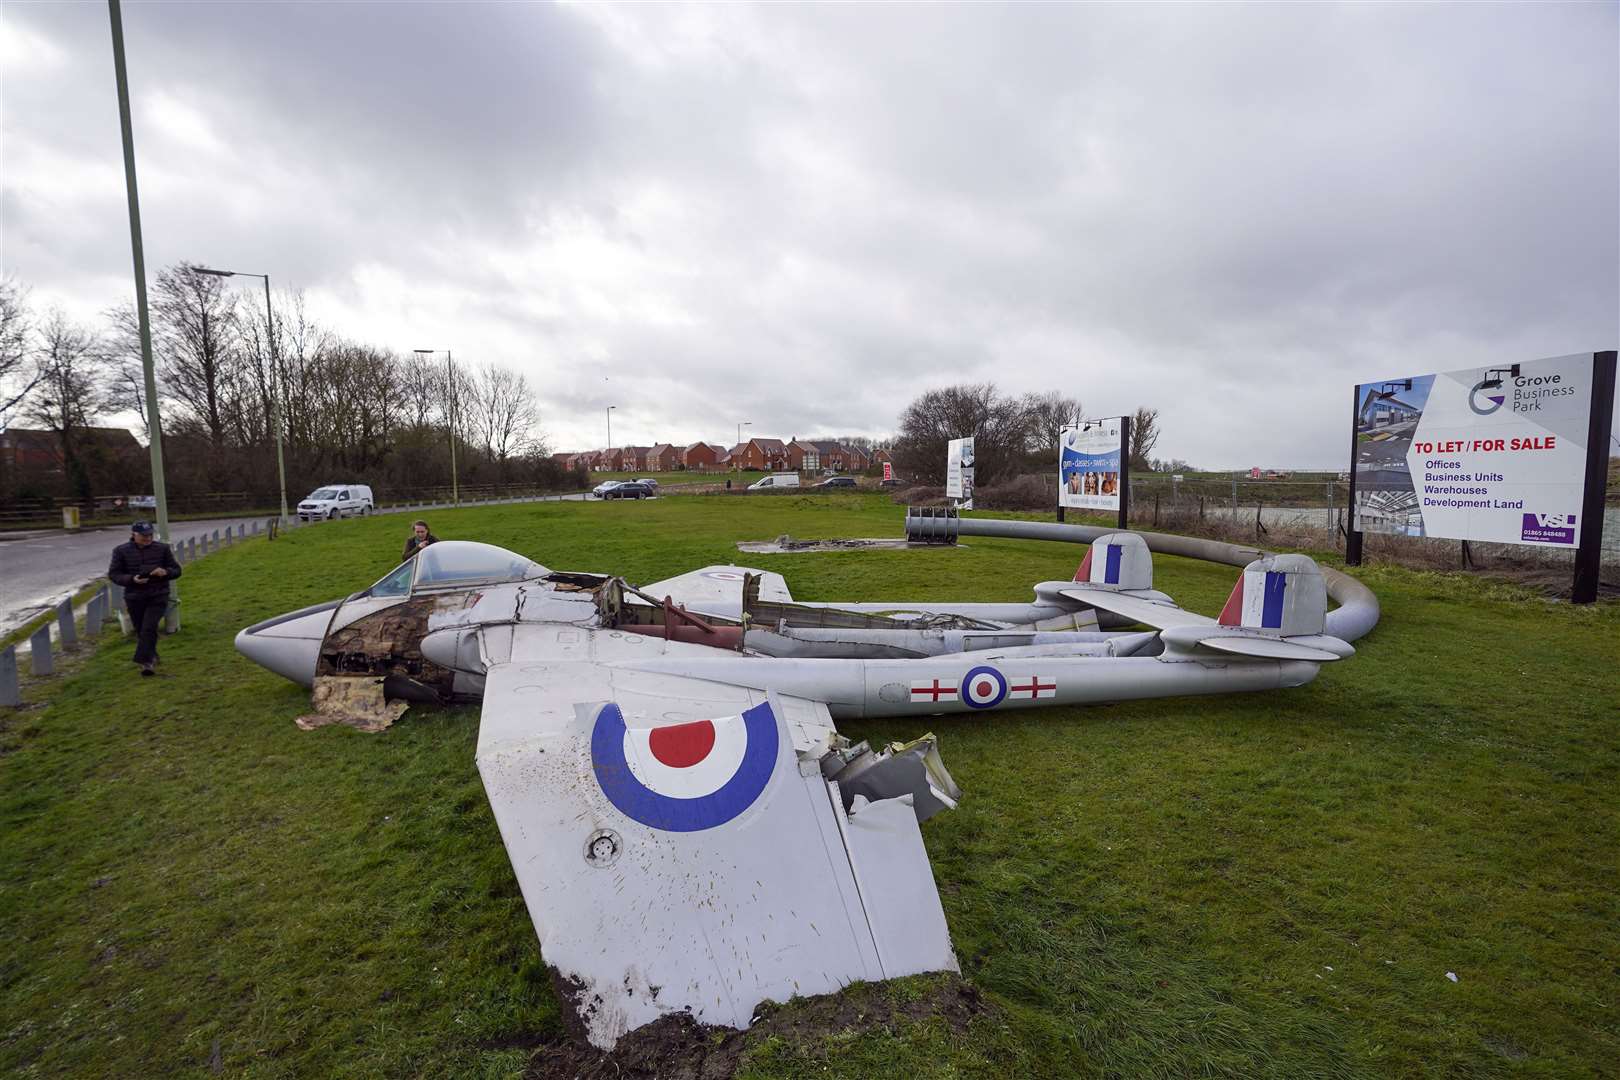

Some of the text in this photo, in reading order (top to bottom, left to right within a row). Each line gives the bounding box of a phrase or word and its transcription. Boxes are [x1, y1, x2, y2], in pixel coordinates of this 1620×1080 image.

[1514, 374, 1561, 387] Grove
[1514, 386, 1575, 401] Business
[1513, 400, 1541, 412] Park
[1415, 443, 1433, 453] TO
[1437, 441, 1464, 453] LET
[1473, 439, 1505, 452] FOR
[1510, 437, 1556, 450] SALE
[1425, 460, 1461, 469] Offices
[1425, 472, 1504, 482] Business Units
[1424, 485, 1488, 495] Warehouses
[1423, 497, 1523, 509] Development Land
